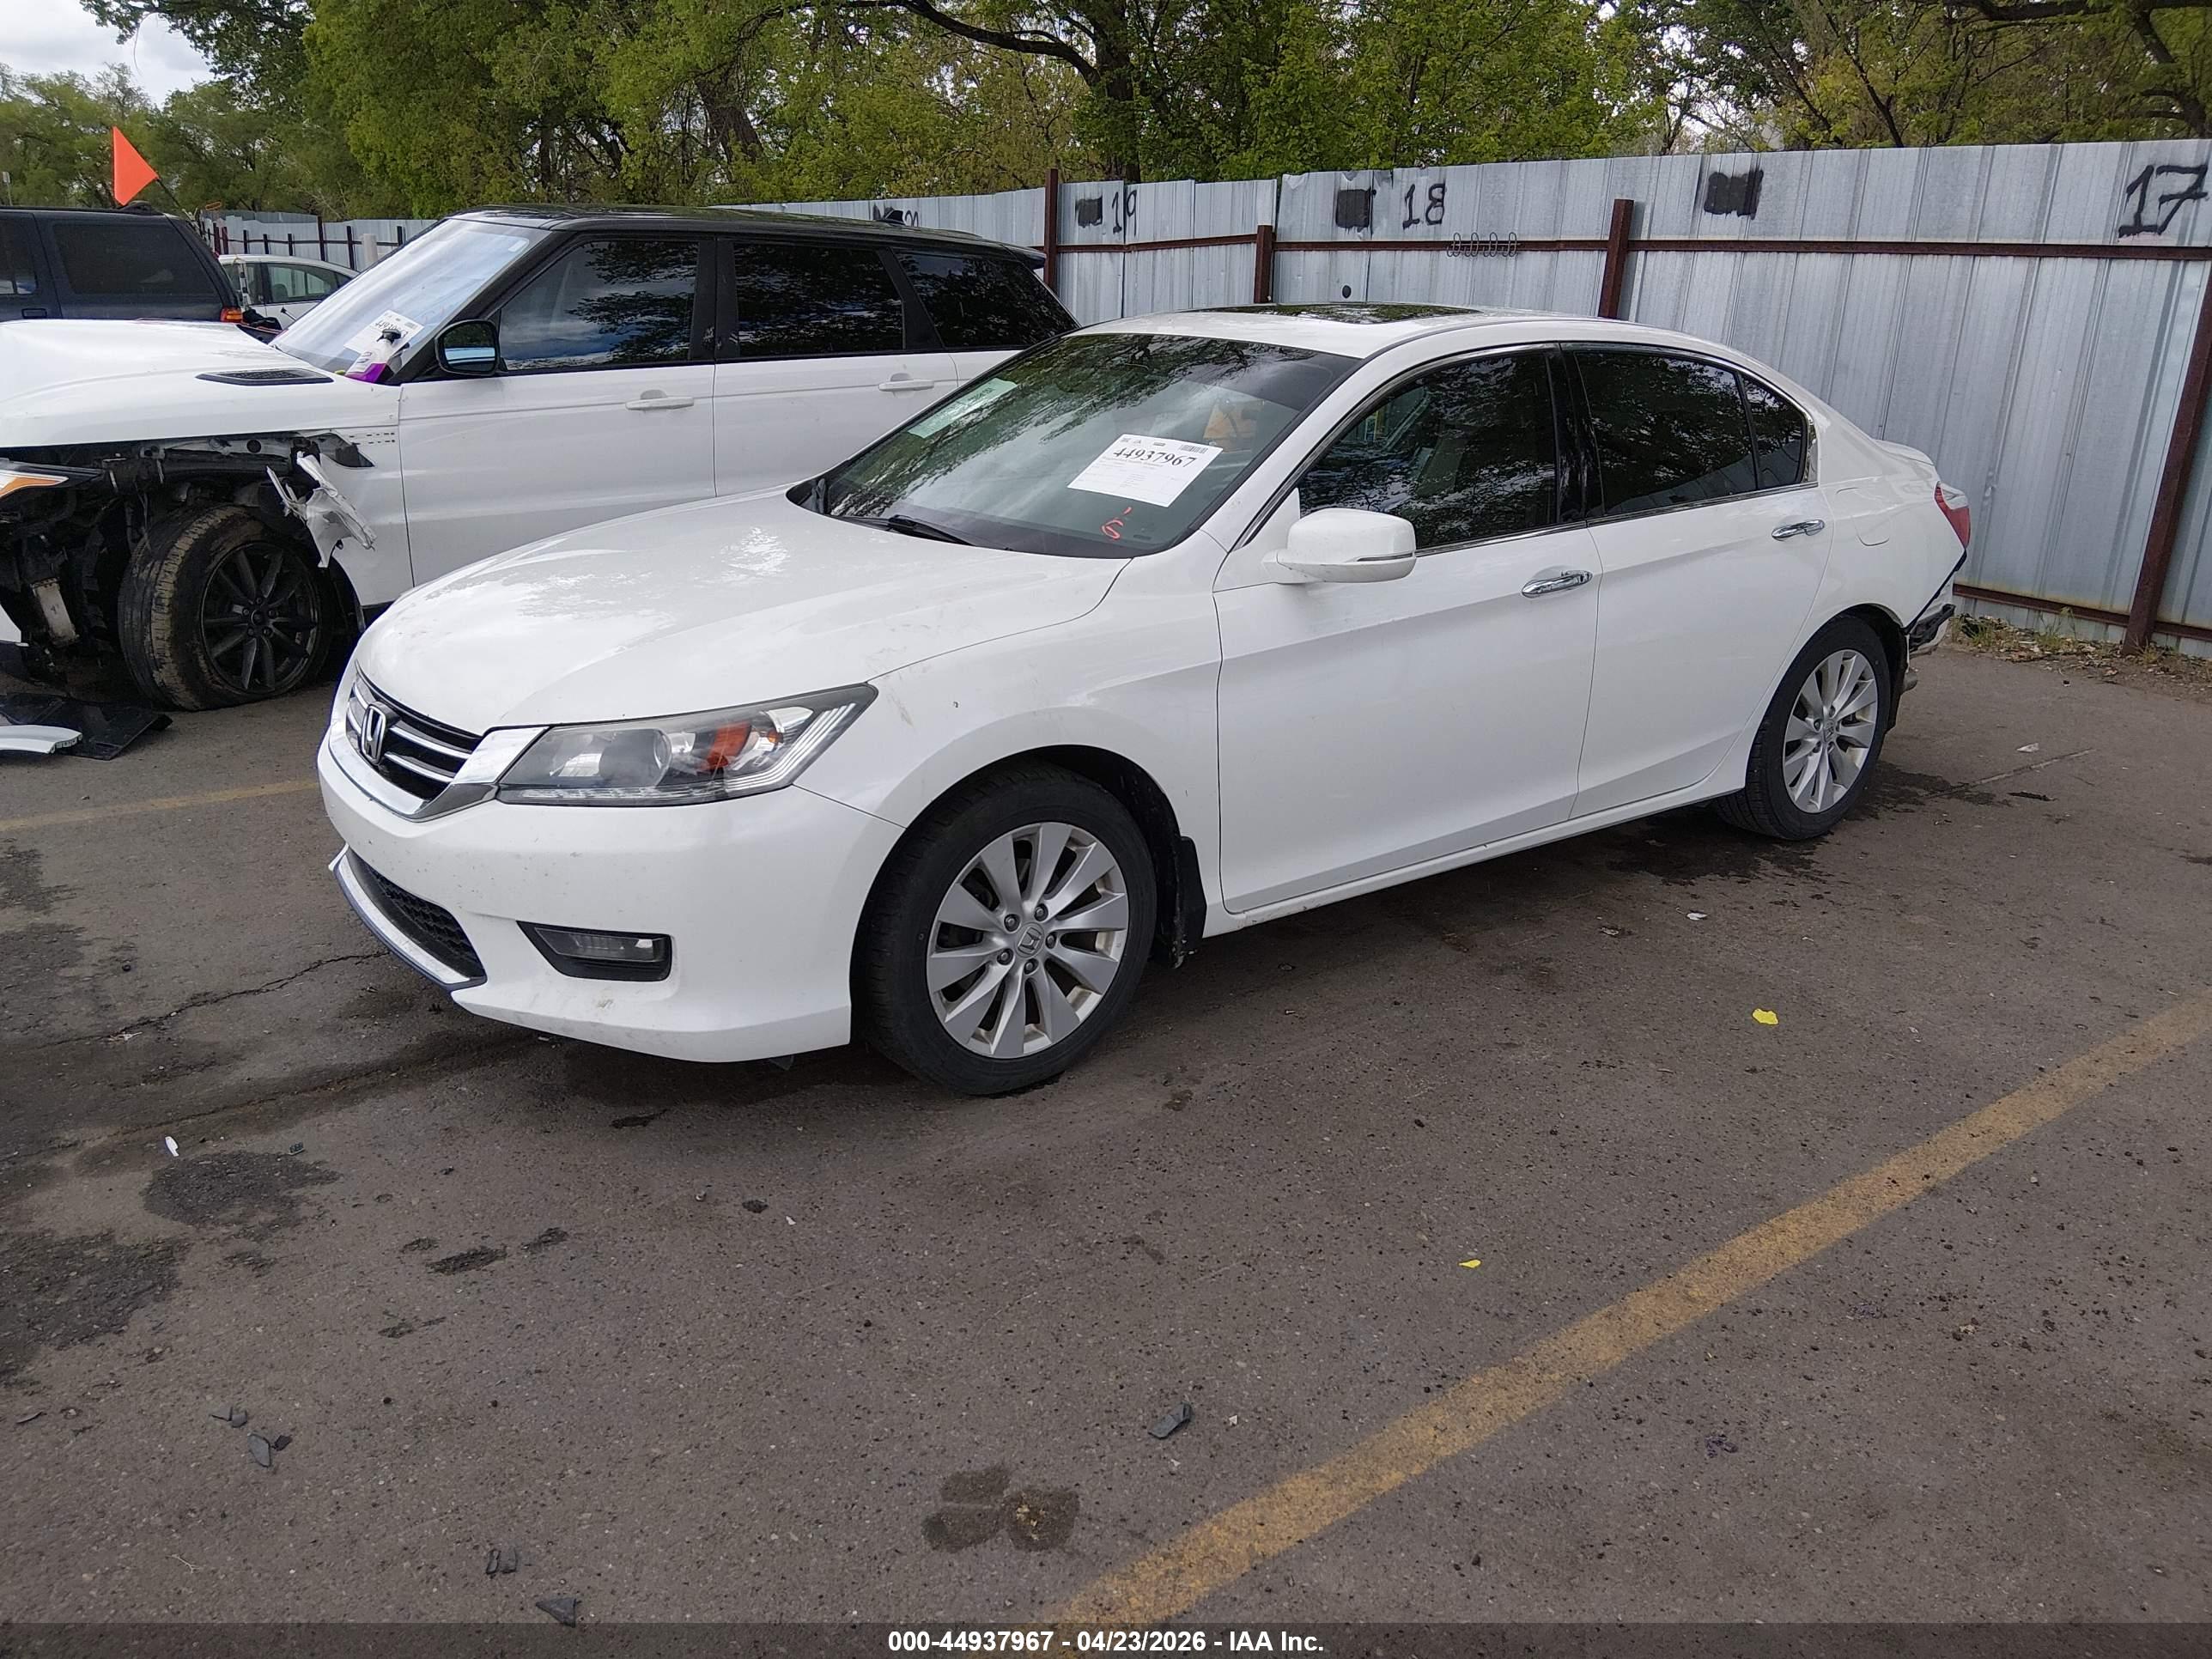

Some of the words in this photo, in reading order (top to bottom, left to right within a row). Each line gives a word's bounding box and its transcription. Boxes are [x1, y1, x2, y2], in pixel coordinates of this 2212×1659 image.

[1111, 189, 1138, 237] 19
[1402, 180, 1446, 230] 18
[2118, 163, 2209, 239] 17
[1113, 447, 1198, 468] 44937967
